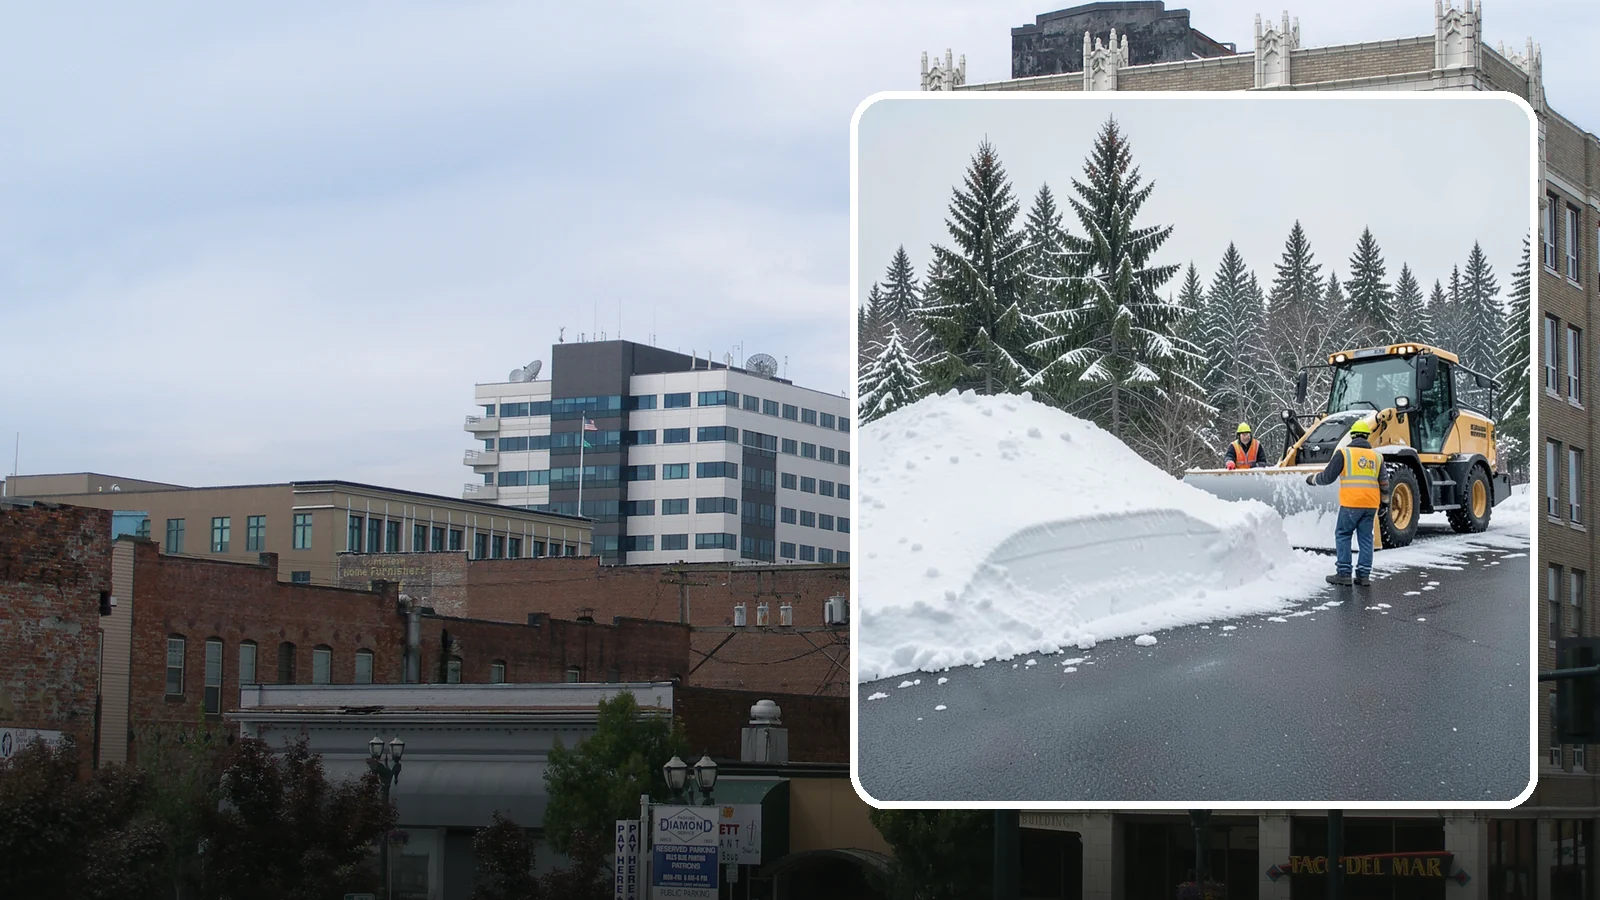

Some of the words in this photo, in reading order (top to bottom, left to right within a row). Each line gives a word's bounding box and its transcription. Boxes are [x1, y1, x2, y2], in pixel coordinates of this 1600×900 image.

[343, 568, 368, 577] Home
[370, 566, 428, 577] Furnishers
[660, 818, 713, 832] DIAMOND
[1022, 815, 1070, 828] BUILDING
[617, 824, 625, 852] PAY
[628, 824, 636, 852] PAY
[656, 845, 688, 853] RESERVED
[689, 846, 716, 854] PARKING
[721, 852, 739, 862] Soup
[671, 862, 701, 870] PATRONS
[1290, 855, 1330, 874] TAC
[1345, 856, 1385, 875] DEL
[1392, 857, 1442, 876] MAR
[616, 856, 625, 893] HERE
[627, 855, 636, 893] HERE
[660, 888, 682, 897] PUBLIC
[683, 889, 710, 898] PARKING
